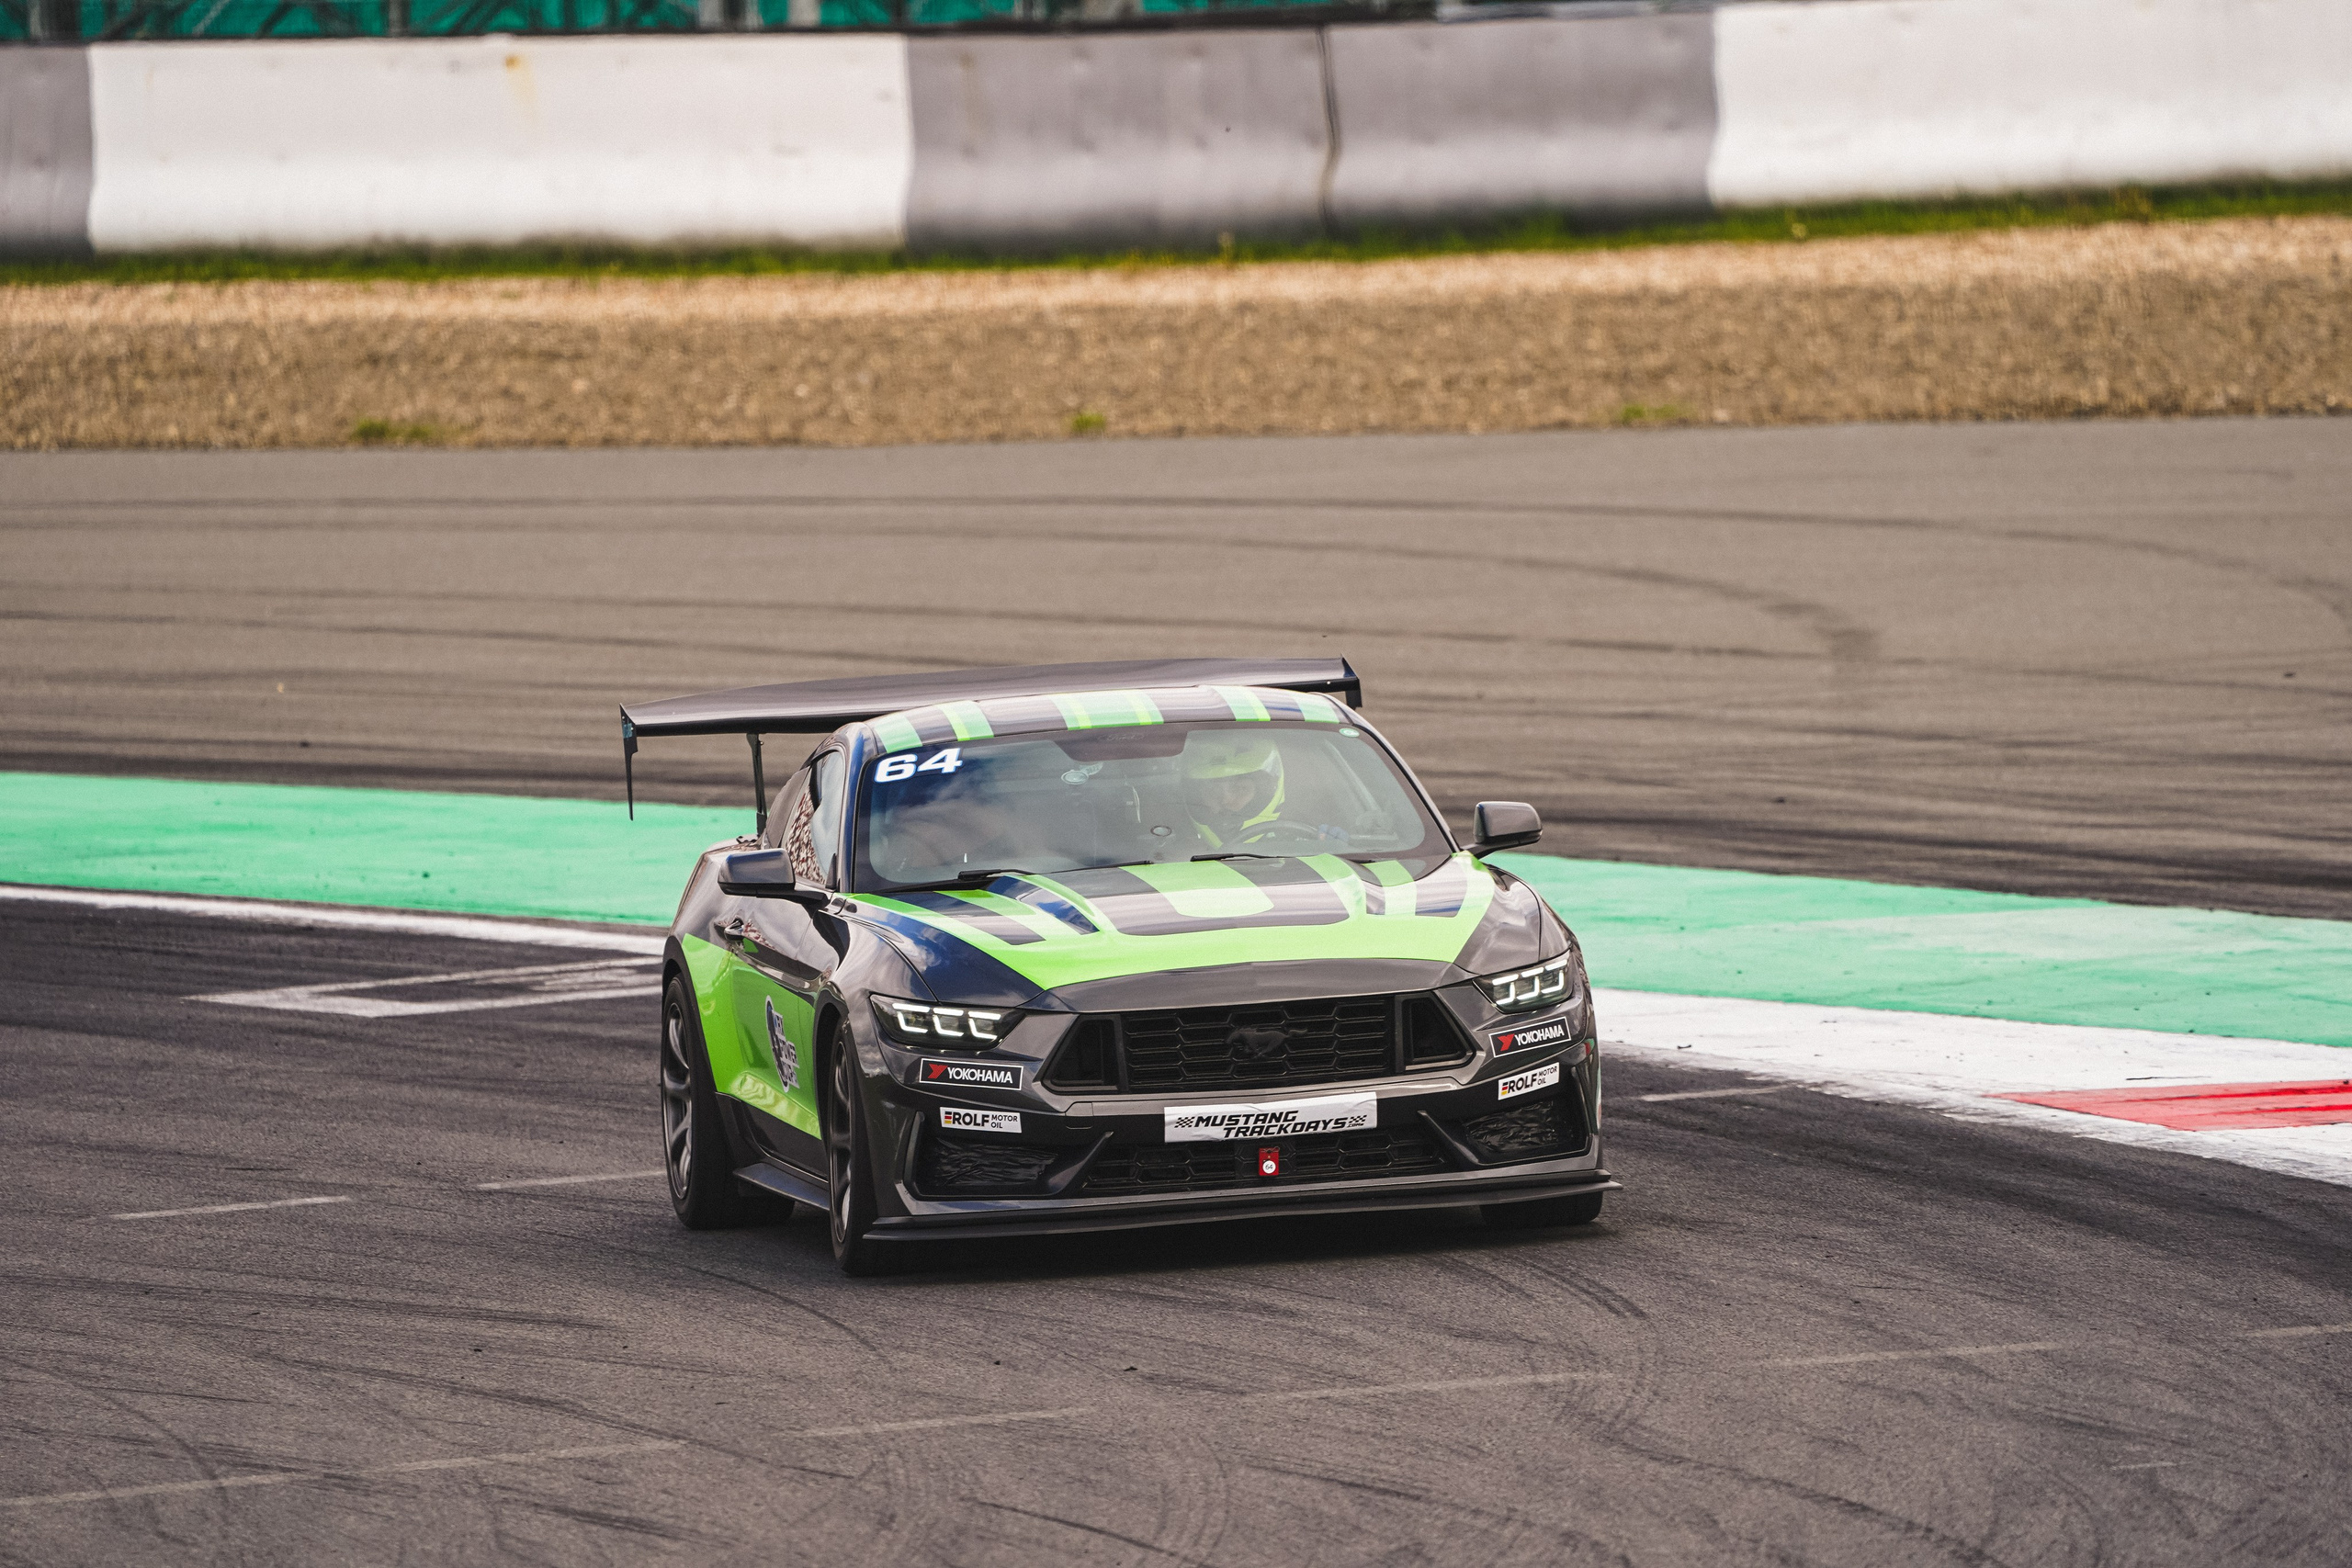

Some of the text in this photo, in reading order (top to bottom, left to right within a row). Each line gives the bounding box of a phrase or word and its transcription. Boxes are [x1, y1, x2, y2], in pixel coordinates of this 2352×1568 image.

[874, 748, 963, 783] 64
[1514, 1024, 1565, 1045] YOKOHAMA
[947, 1066, 1013, 1084] YOKOHAMA
[1508, 1066, 1557, 1093] ROLF MOTOR
[1537, 1077, 1546, 1086] OIL
[952, 1111, 1018, 1127] ROLF MOTOR
[1194, 1111, 1298, 1127] MUSTANG
[1223, 1117, 1348, 1138] TRACKDAYS
